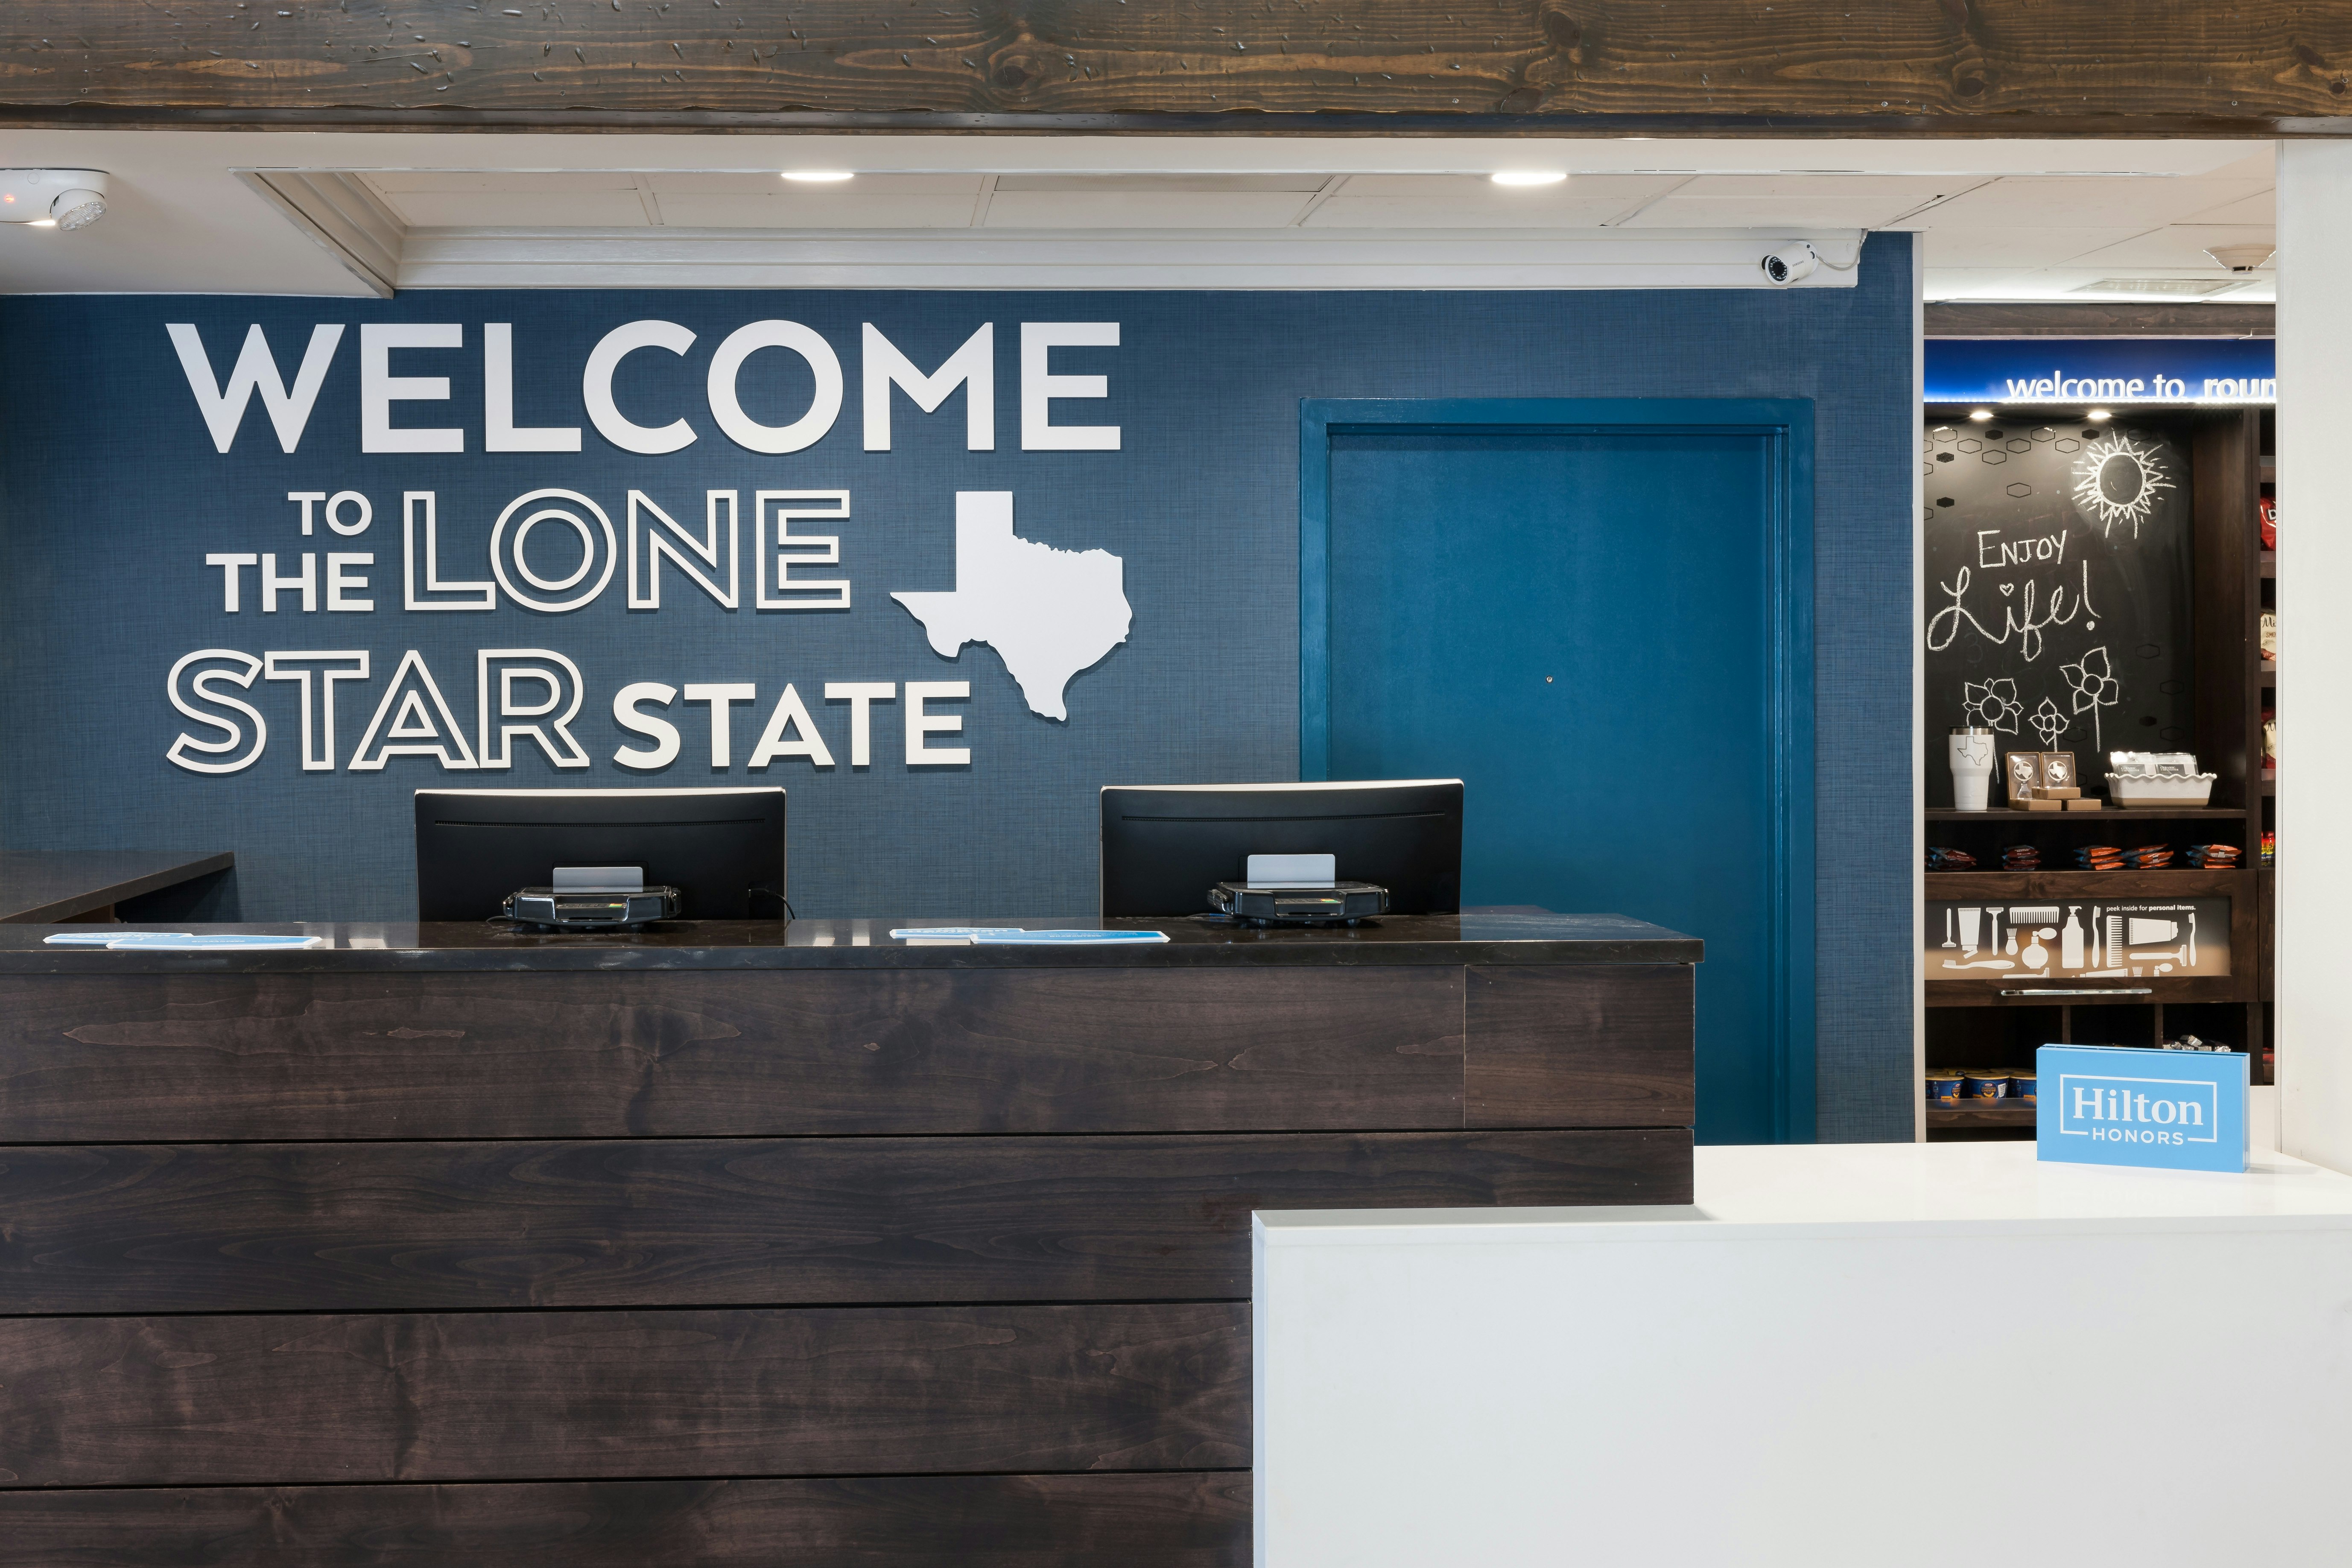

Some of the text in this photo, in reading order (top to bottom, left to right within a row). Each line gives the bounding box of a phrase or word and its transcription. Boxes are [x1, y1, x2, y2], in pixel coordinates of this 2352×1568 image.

[165, 320, 1121, 453] WELCOME
[2007, 370, 2144, 398] welcome
[2153, 374, 2185, 398] to
[288, 491, 372, 535] TO
[206, 488, 850, 612] THE LONE
[1927, 560, 2101, 662] Life!
[167, 648, 970, 773] STAR STATE
[2073, 1087, 2203, 1125] Hilton
[2093, 1127, 2184, 1145] HONORS
